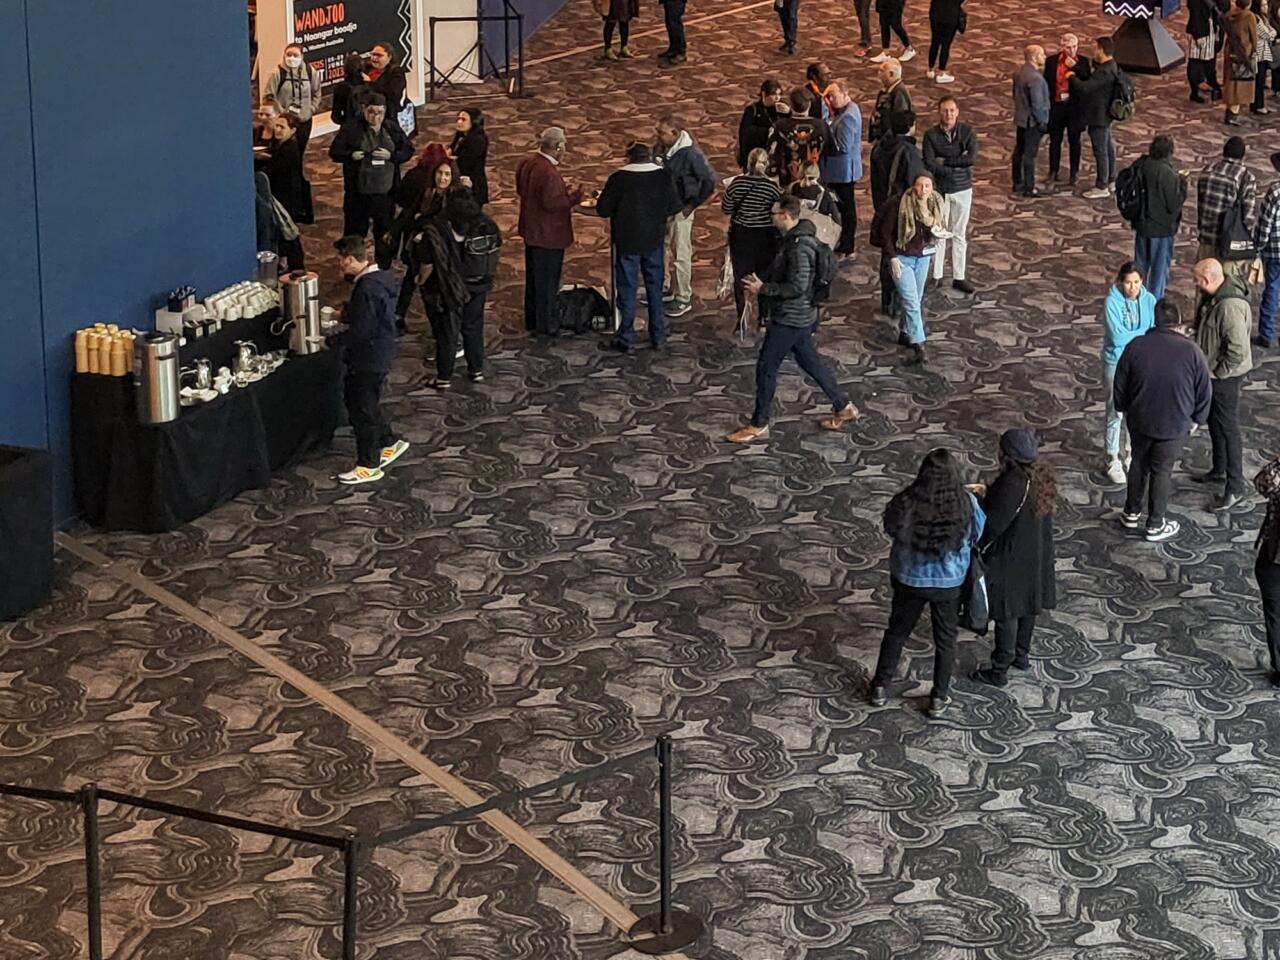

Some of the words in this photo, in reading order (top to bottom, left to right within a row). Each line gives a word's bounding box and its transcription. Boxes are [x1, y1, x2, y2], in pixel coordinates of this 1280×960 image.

[294, 2, 345, 32] WANDJOO
[295, 34, 303, 44] to
[304, 28, 333, 43] Noongar
[334, 22, 358, 36] boodja
[328, 61, 344, 70] JUNE
[328, 67, 345, 79] 2023
